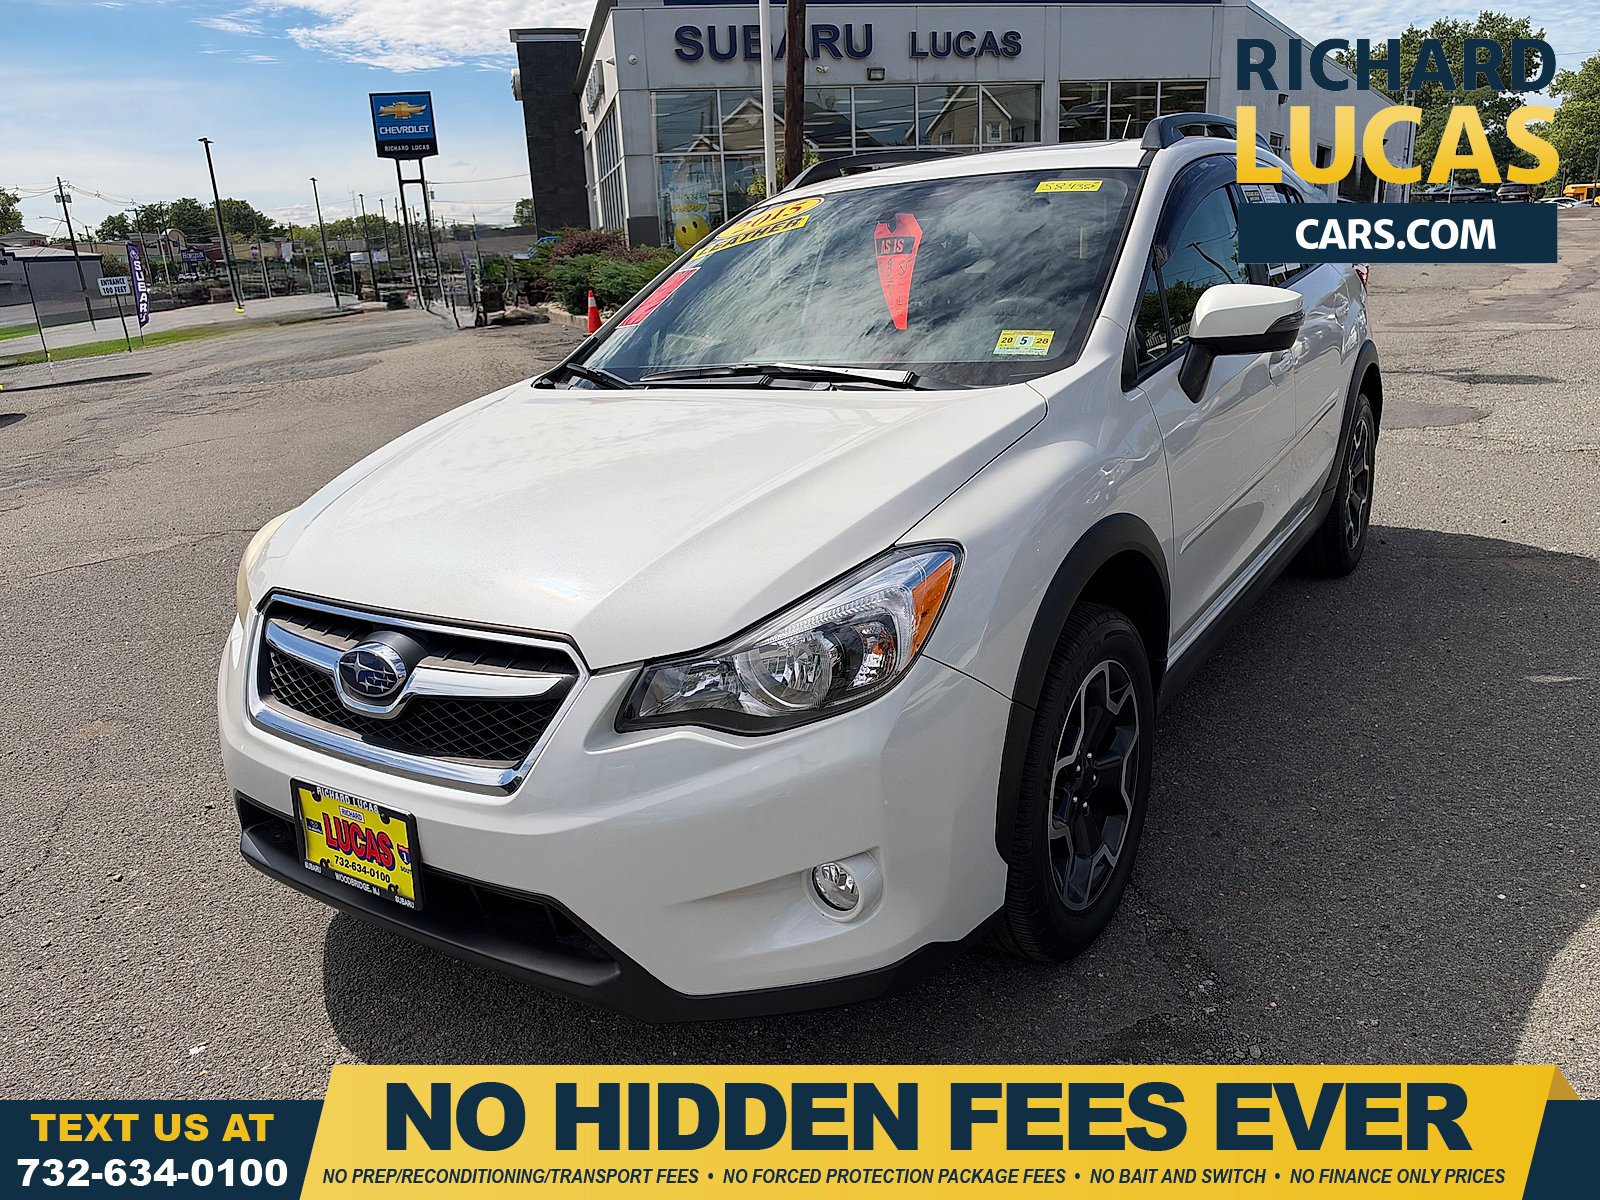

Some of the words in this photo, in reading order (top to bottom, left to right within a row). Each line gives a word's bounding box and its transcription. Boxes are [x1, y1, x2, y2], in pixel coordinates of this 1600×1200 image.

[909, 30, 1023, 59] LUCAS
[380, 125, 429, 135] CHEVROLET
[698, 217, 805, 257] LEATHER
[880, 239, 891, 255] AS
[893, 238, 905, 254] IS
[100, 277, 126, 287] ENTRANCE
[114, 285, 127, 294] FEET
[1001, 336, 1013, 344] 20
[1019, 336, 1029, 345] 5
[316, 786, 350, 805] RICHARD
[352, 797, 380, 814] LUCAS
[341, 808, 363, 821] RICHARD
[321, 812, 396, 871] LUCAS
[304, 861, 322, 874] SUBARU
[334, 854, 391, 884] 732-634-0100
[372, 885, 380, 896] NJ
[395, 895, 415, 909] SUBARU
